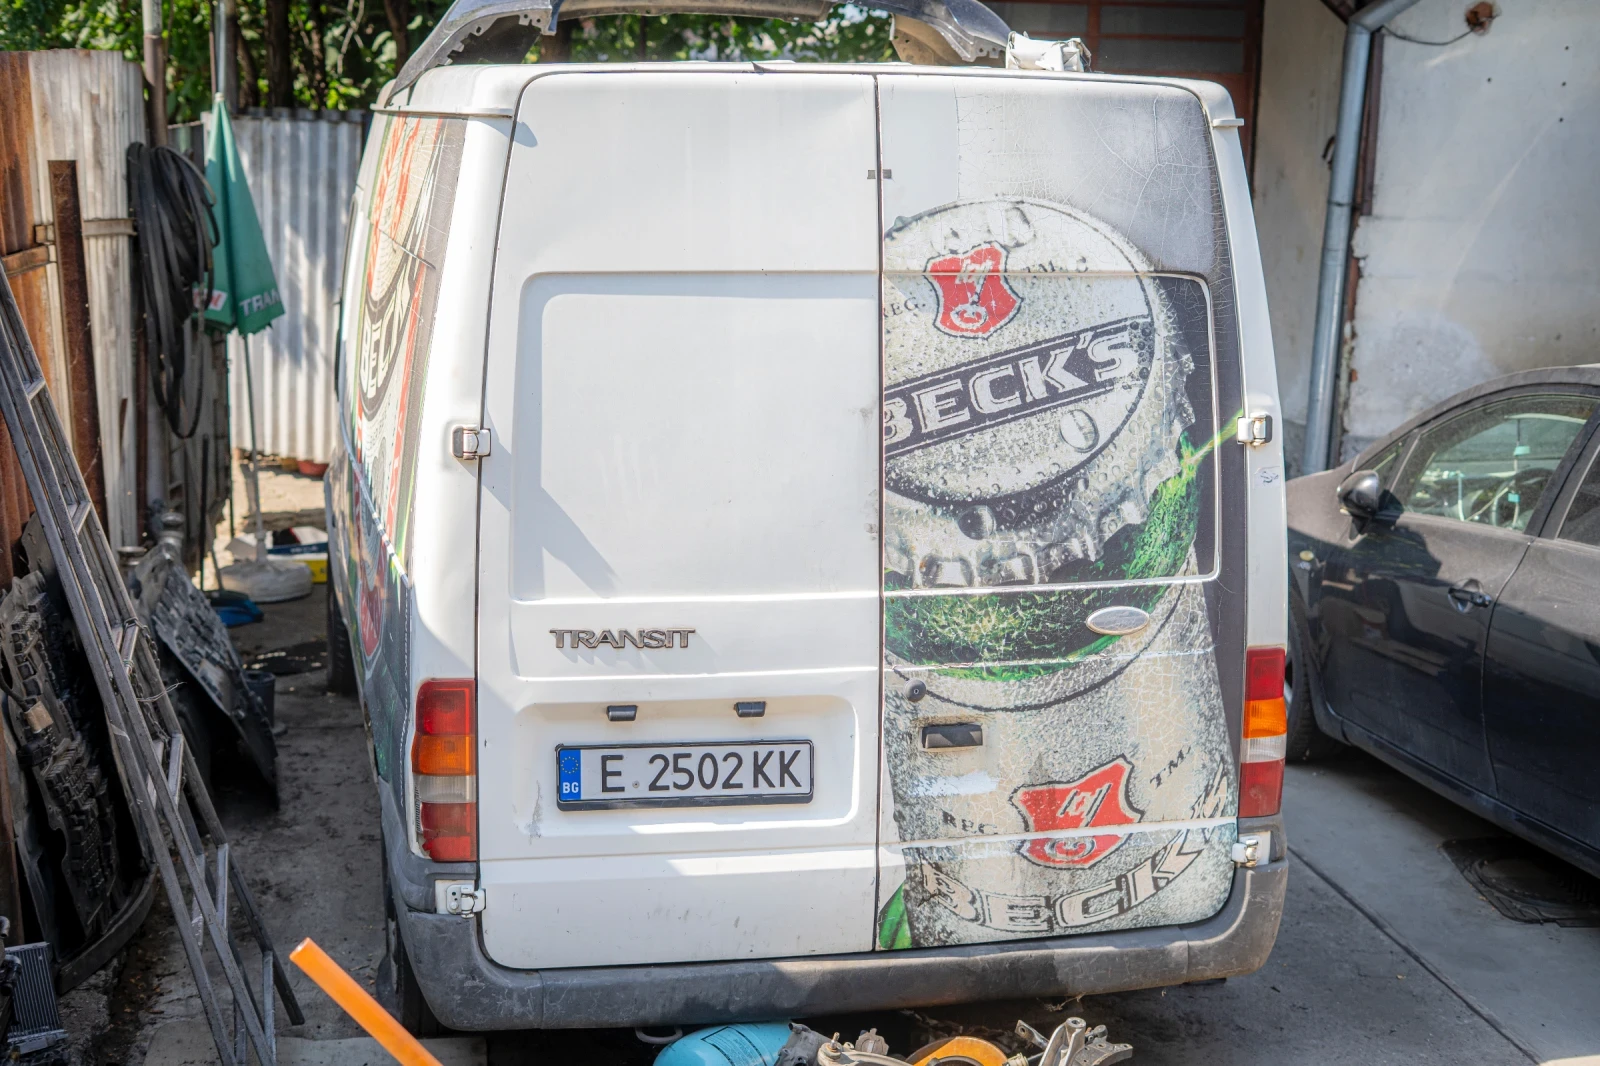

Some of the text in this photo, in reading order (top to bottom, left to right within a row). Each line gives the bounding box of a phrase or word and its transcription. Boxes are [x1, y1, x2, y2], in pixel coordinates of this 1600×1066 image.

[549, 628, 696, 649] TRANSIT
[601, 754, 626, 793] E
[562, 782, 579, 794] BG
